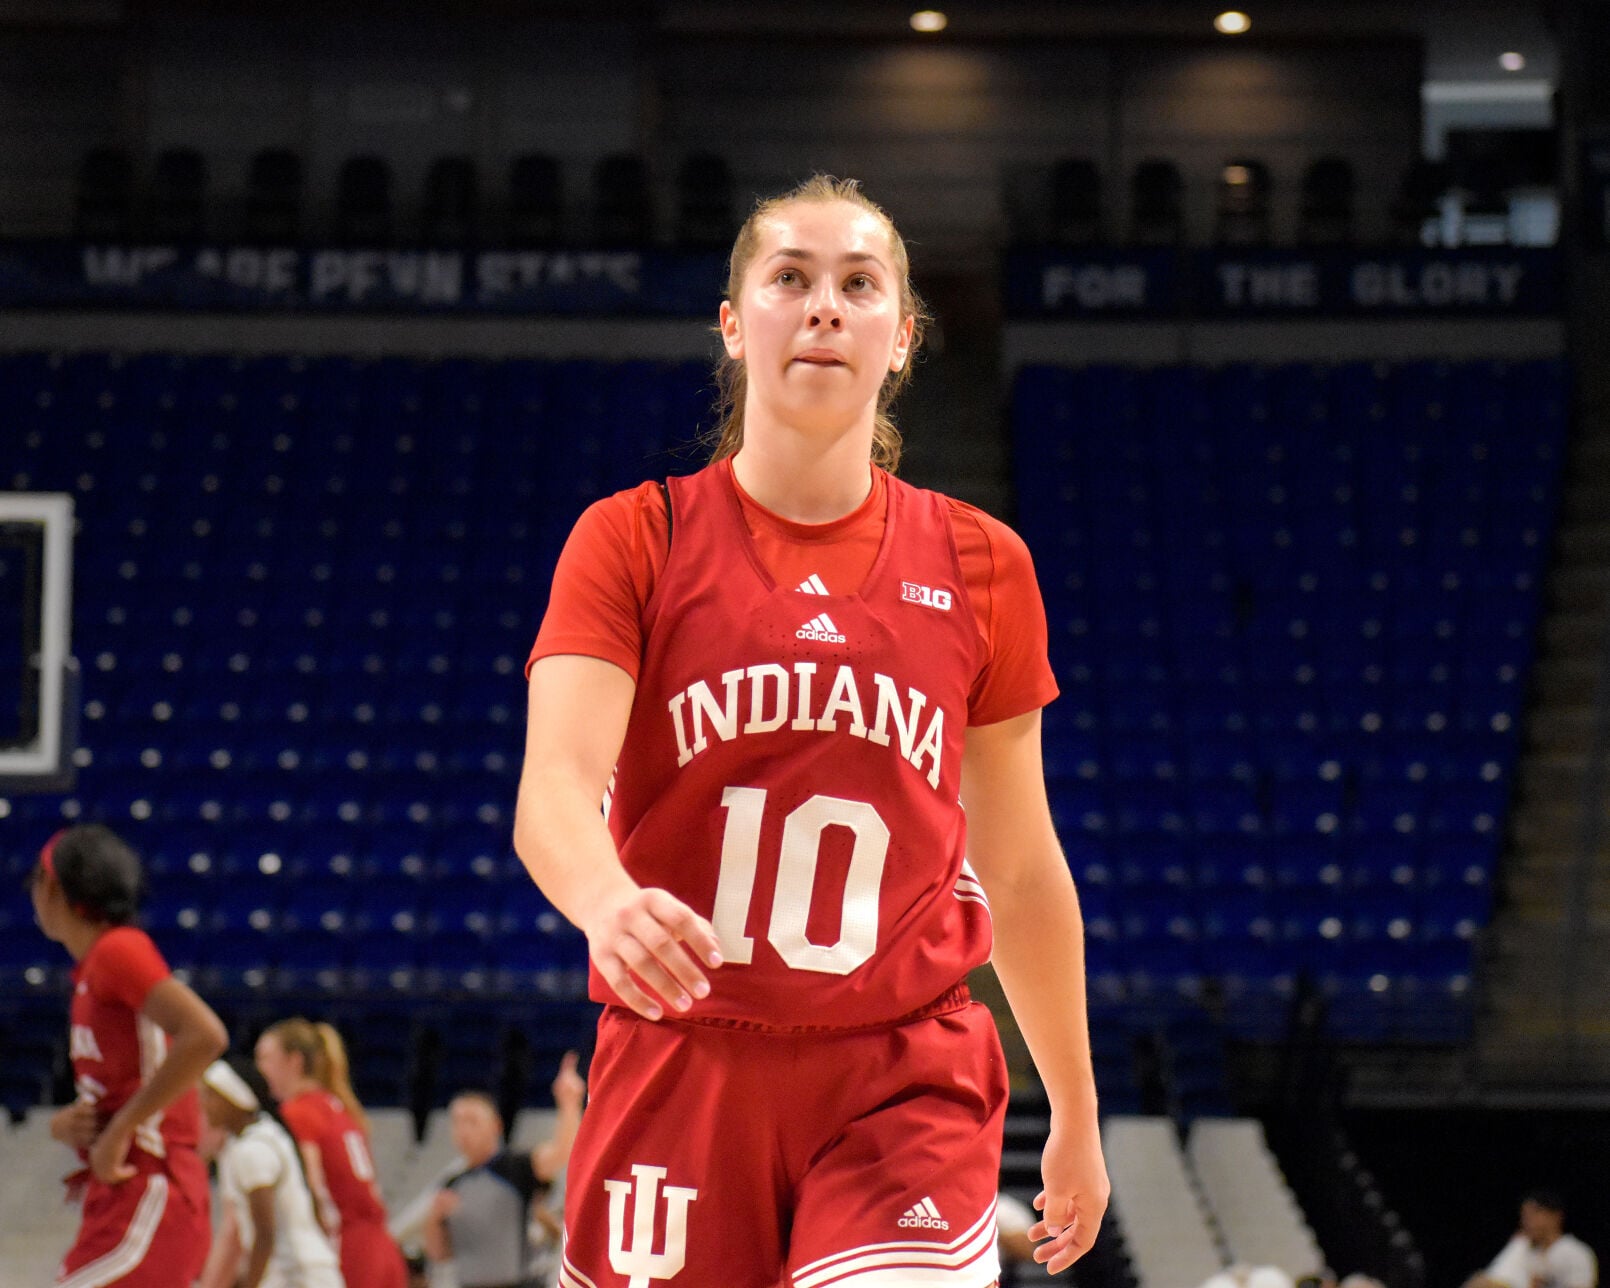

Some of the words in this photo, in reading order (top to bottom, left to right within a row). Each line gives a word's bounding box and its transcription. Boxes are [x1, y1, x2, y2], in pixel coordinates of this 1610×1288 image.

[1042, 263, 1147, 307] FOR
[1217, 262, 1318, 307] THE
[1351, 262, 1524, 307] GLORY
[795, 629, 847, 644] adidas
[668, 662, 944, 790] INDIANA
[711, 786, 890, 975] 10
[897, 1215, 950, 1231] adidas
